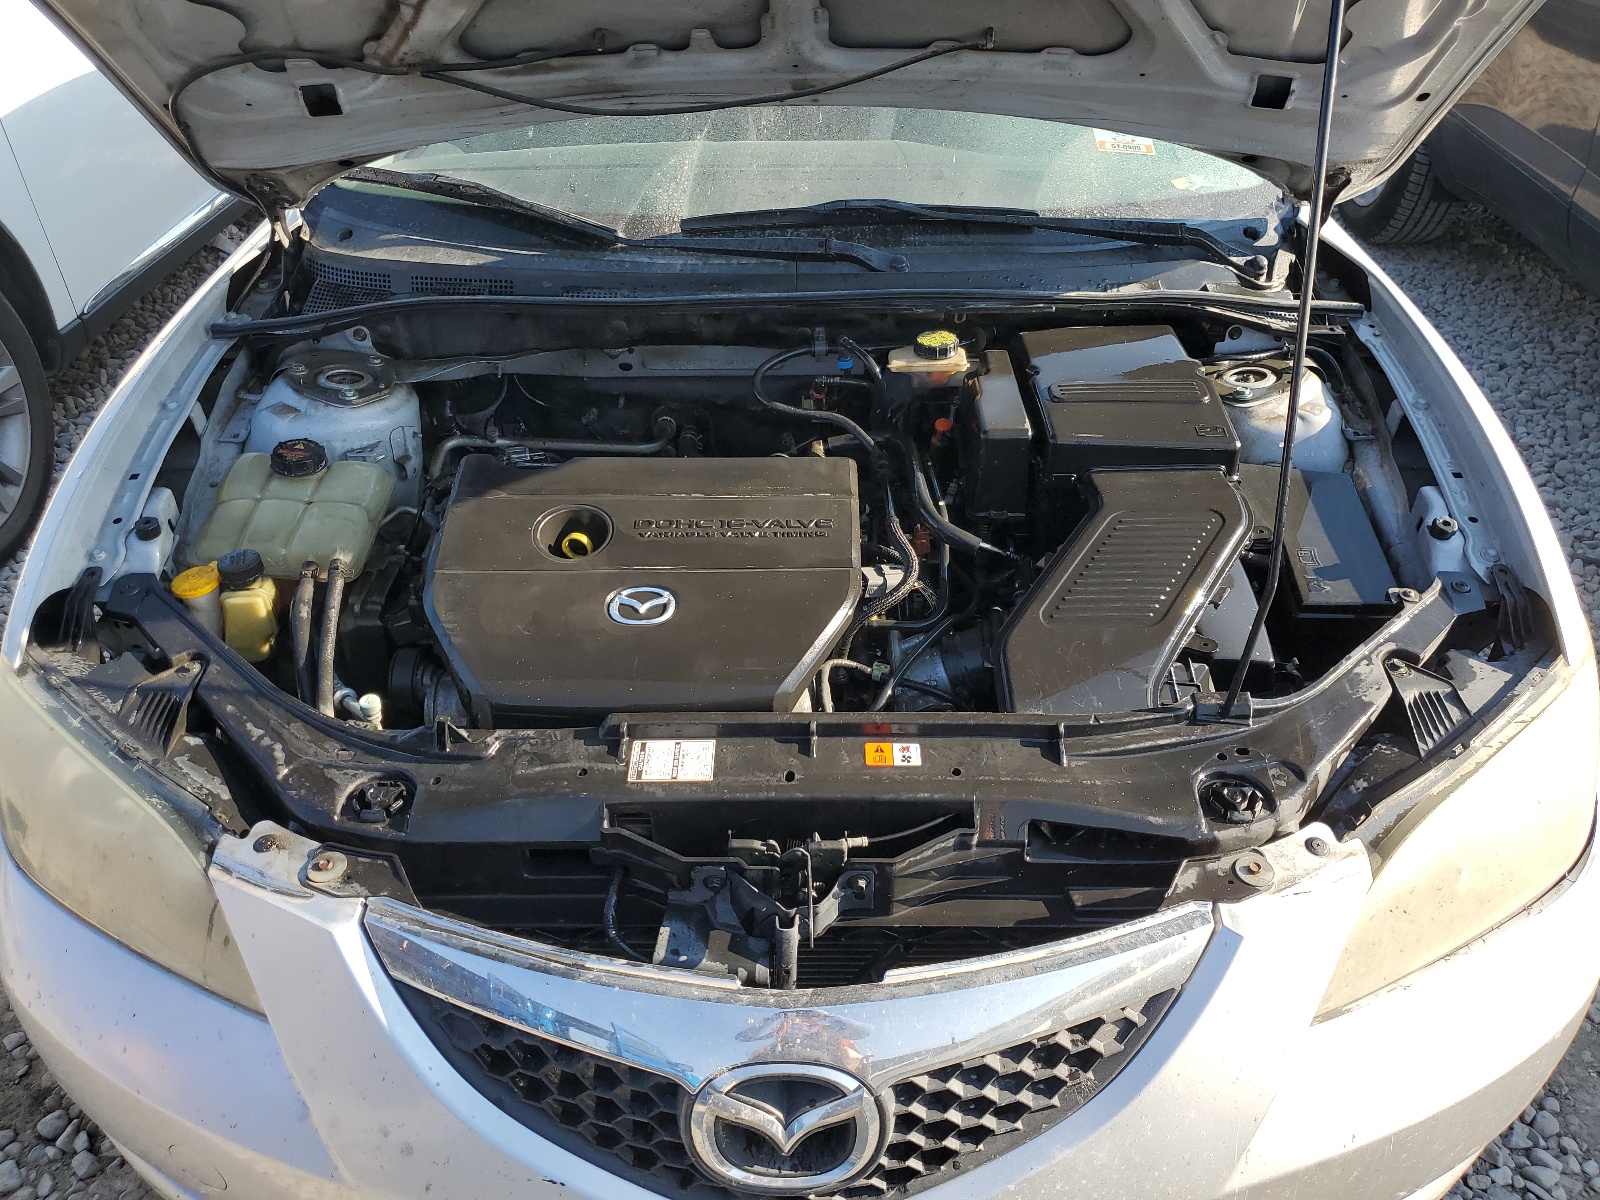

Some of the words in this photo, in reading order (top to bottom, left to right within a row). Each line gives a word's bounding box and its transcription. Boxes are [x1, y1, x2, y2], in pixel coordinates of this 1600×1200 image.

[633, 518, 715, 529] DOHC
[719, 518, 834, 529] 16-VALVE
[638, 530, 717, 538] VARIABLE
[720, 530, 769, 538] VALVE
